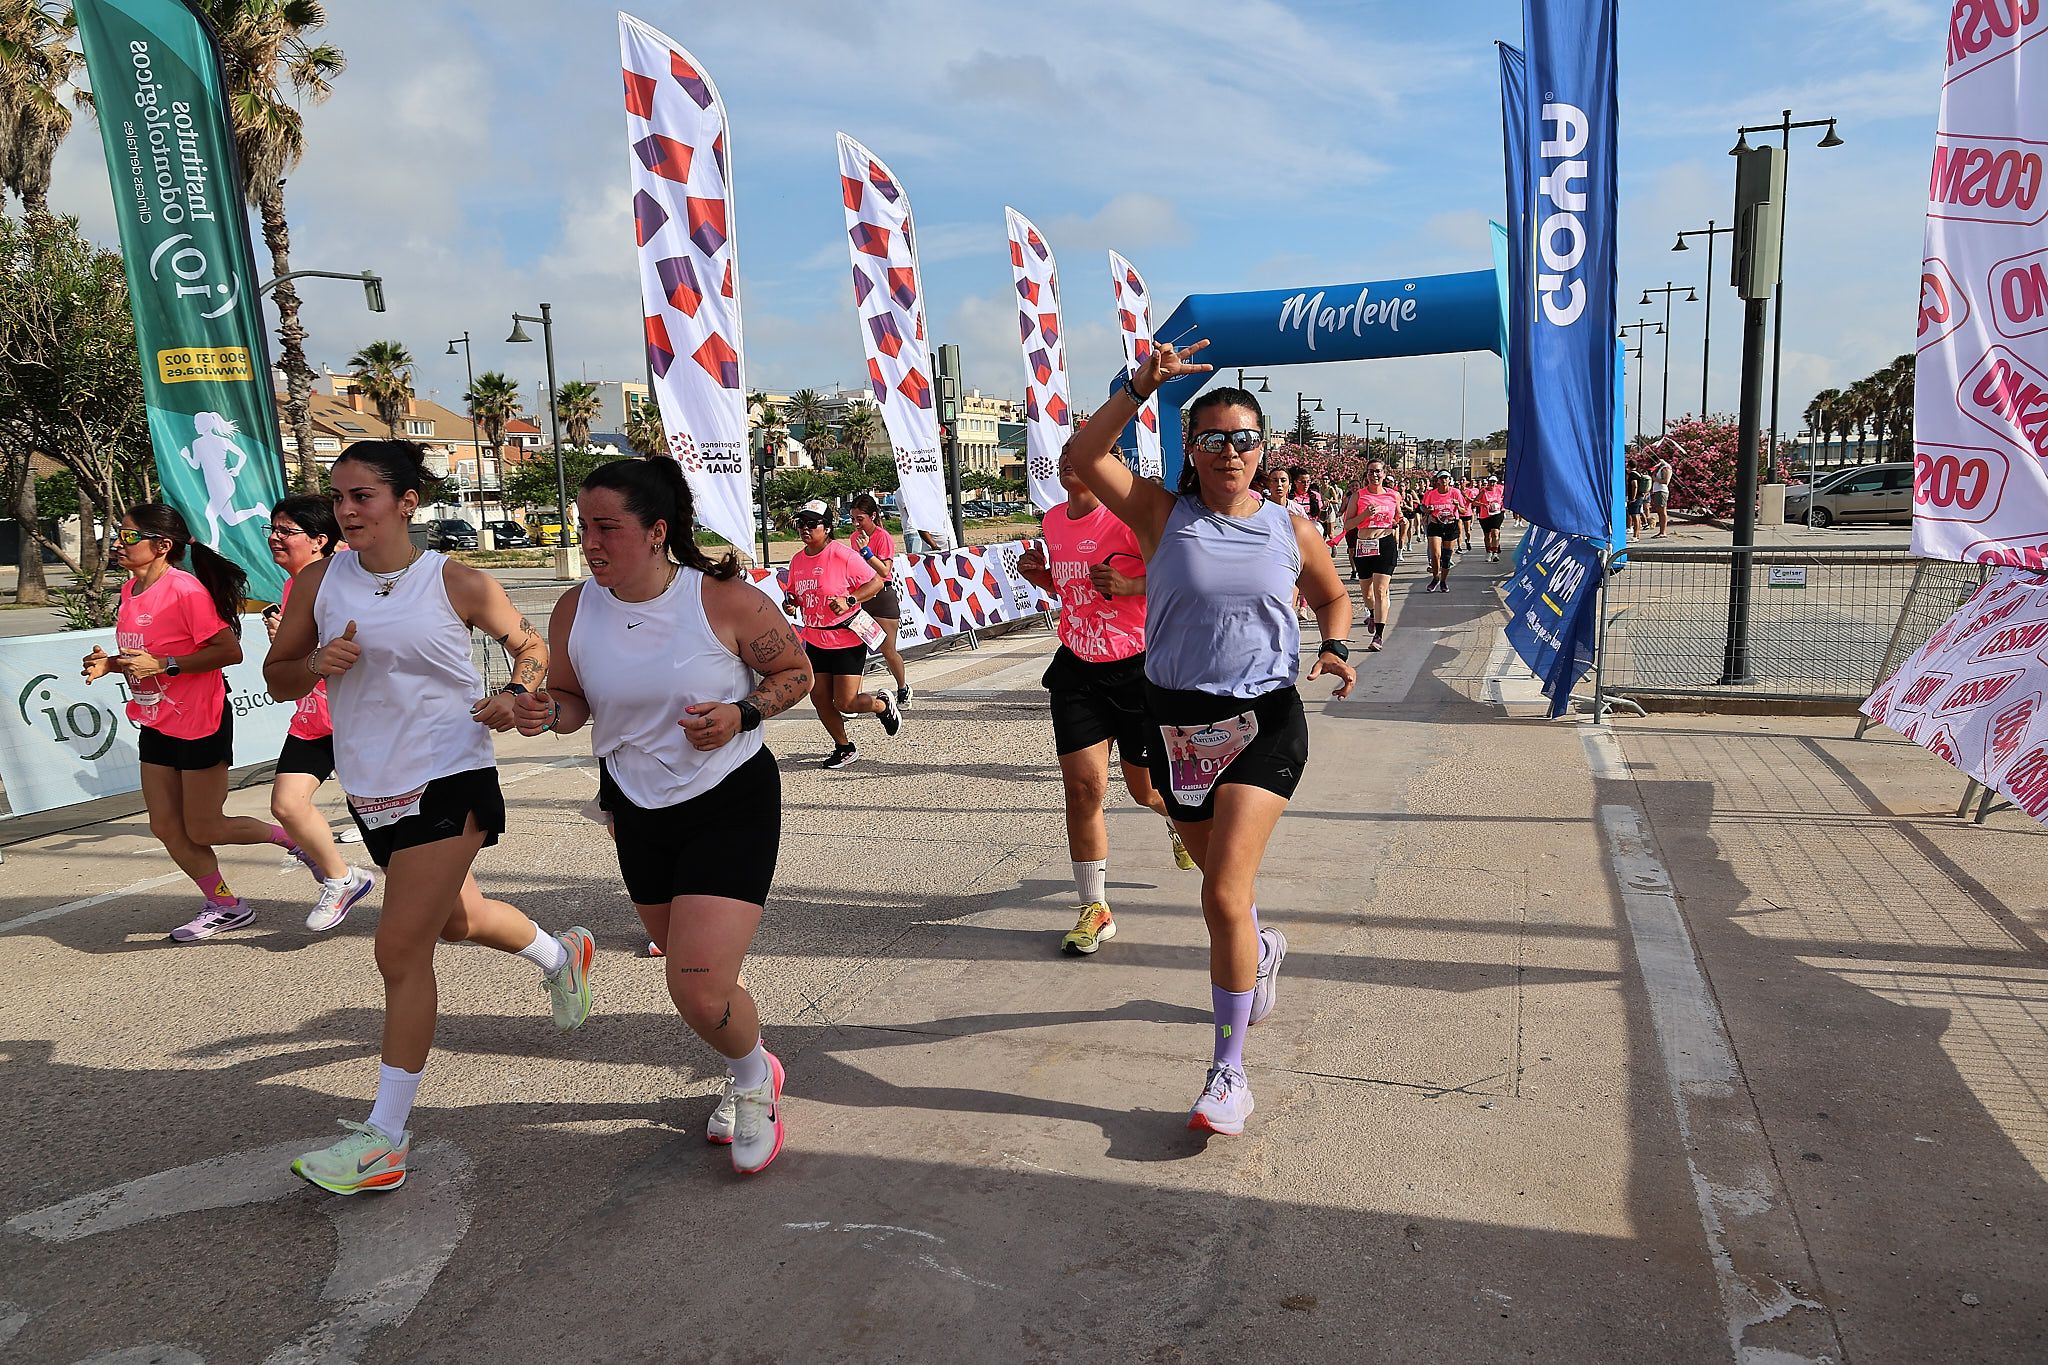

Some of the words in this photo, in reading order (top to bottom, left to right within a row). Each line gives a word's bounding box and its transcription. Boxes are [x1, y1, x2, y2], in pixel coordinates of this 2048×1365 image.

[1278, 288, 1417, 351] Marlene
[1051, 561, 1090, 580] ARRERA
[1547, 555, 1586, 604] GOYA
